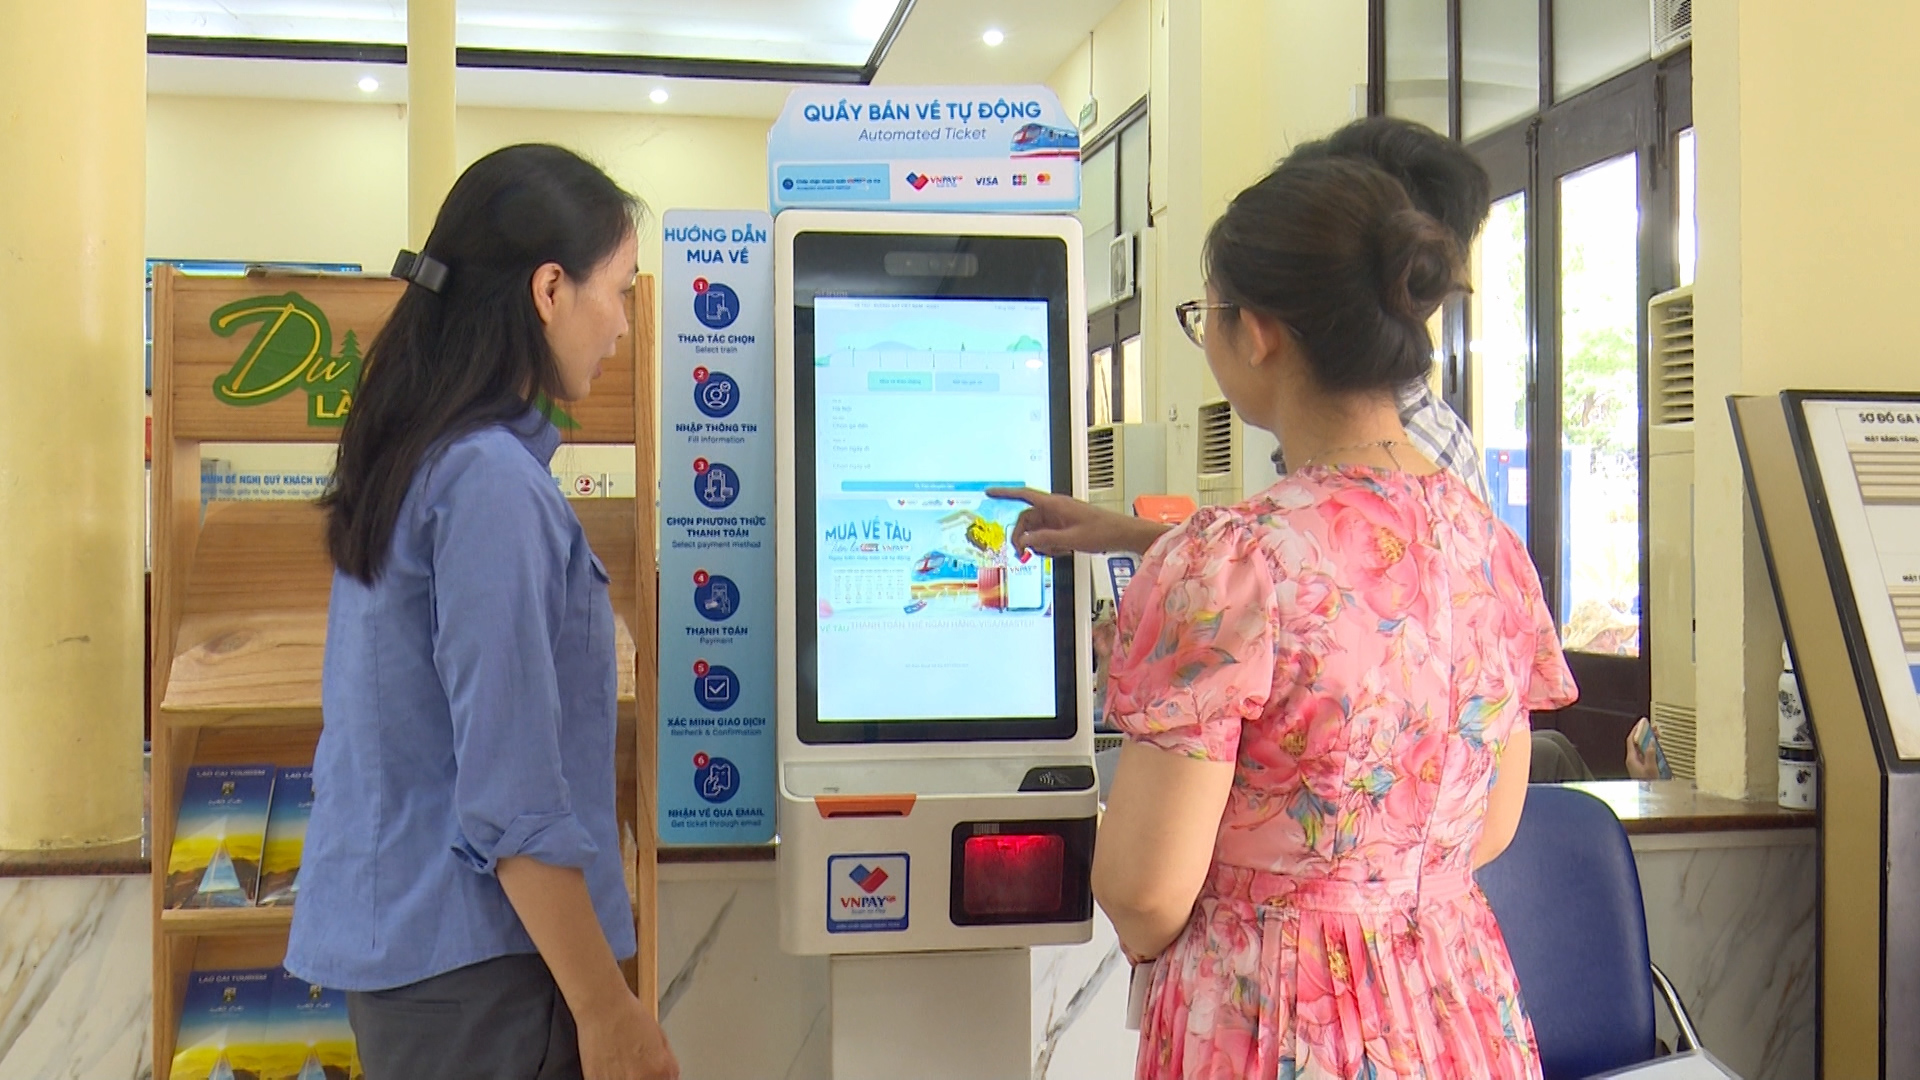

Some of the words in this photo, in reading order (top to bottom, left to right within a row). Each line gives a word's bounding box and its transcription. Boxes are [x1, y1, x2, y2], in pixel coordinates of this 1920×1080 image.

[869, 98, 910, 121] BÁN
[946, 101, 973, 123] TỰ
[978, 98, 1042, 123] ĐỘNG
[858, 128, 940, 142] Automated
[945, 127, 987, 140] Ticket
[975, 177, 999, 186] VISA
[664, 224, 727, 242] HƯỚNG
[687, 249, 724, 263] MUA
[728, 246, 750, 263] VÉ
[677, 334, 705, 343] THAO
[706, 333, 725, 343] TÁC
[727, 334, 755, 345] CHỌN
[218, 301, 351, 399] Du
[695, 345, 719, 353] Select
[720, 345, 738, 353] train
[1858, 412, 1875, 424] SƠ
[1877, 411, 1895, 424] ĐỒ
[1896, 413, 1915, 424] GA
[675, 422, 703, 433] NHẬP
[705, 422, 739, 432] THÔNG
[740, 423, 757, 432] TIN
[688, 435, 699, 443] Fill
[283, 474, 312, 485] KHÁCH
[666, 516, 694, 527] CHỌN
[696, 517, 738, 526] PHƯƠNG
[739, 515, 766, 526] THỨC
[687, 529, 720, 538] THANH
[722, 528, 749, 538] TOÁN
[825, 521, 858, 542] MUA
[884, 520, 912, 543] TÀU
[697, 541, 730, 549] payment
[685, 627, 720, 636] THANH
[721, 626, 748, 636] TOÁN
[699, 637, 733, 645] Payment
[667, 716, 687, 726] XÁC
[689, 717, 715, 726] MINH
[717, 717, 741, 727] GIAO
[742, 717, 766, 727] DỊCH
[196, 770, 213, 778] LAO
[668, 808, 696, 818] NHẬN
[713, 809, 733, 818] QUA
[735, 808, 765, 817] EMAIL
[671, 819, 685, 828] Get
[686, 819, 708, 828] ticket
[709, 819, 740, 829] through
[740, 819, 761, 827] email
[840, 895, 886, 908] VNPAY
[198, 974, 215, 984] LAO
